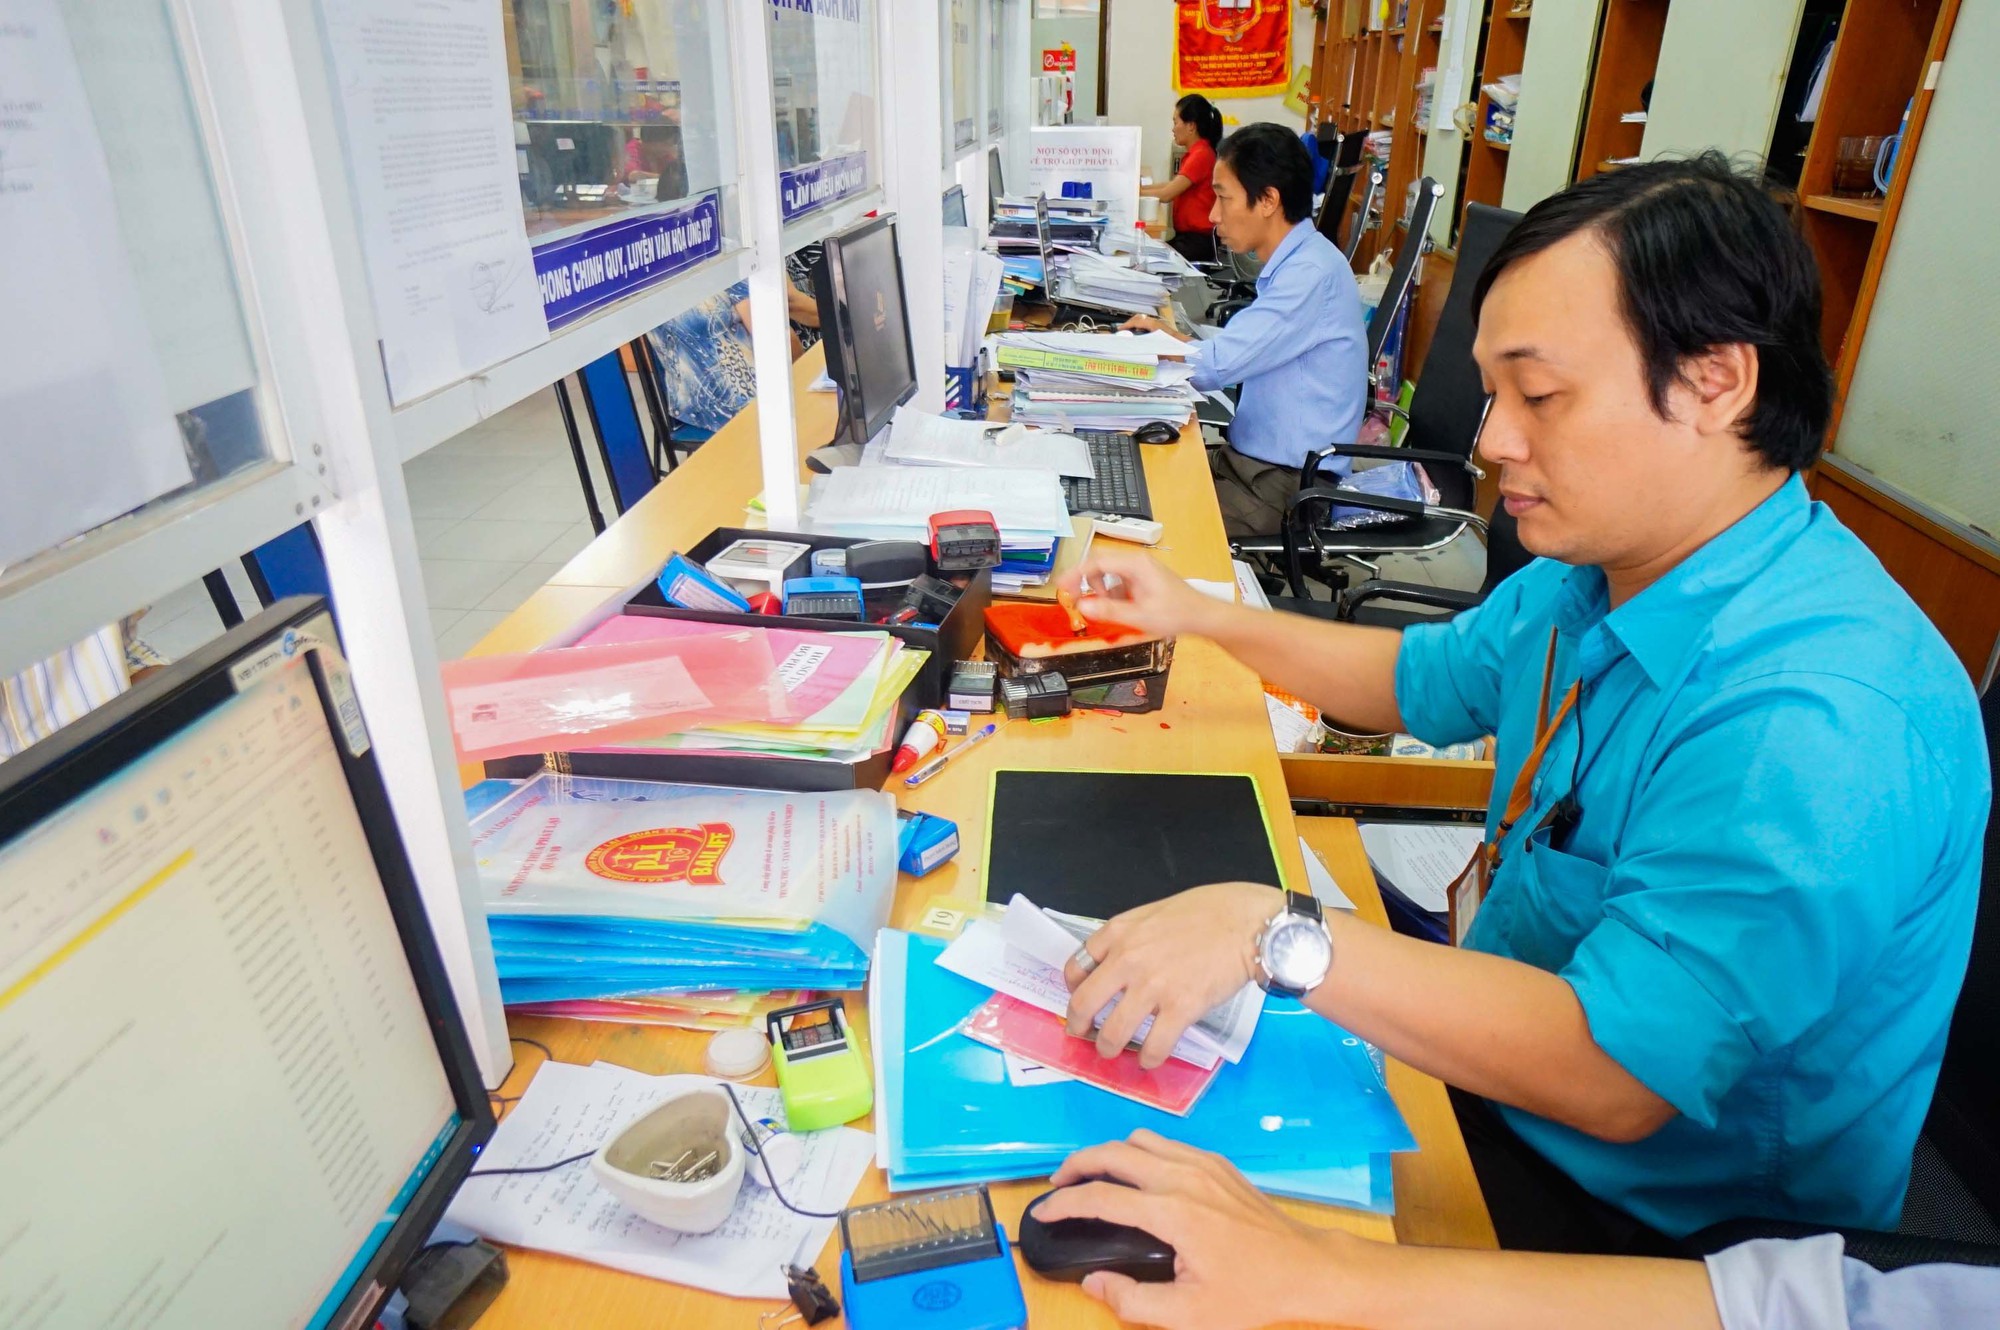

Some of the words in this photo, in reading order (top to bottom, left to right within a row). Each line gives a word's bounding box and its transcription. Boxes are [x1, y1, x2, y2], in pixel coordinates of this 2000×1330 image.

[1071, 147, 1089, 157] QUY
[572, 250, 606, 294] CHÍNH
[605, 246, 628, 279] QUY,
[627, 231, 656, 273] LUYỆN
[654, 227, 672, 261] VĂN
[671, 220, 688, 254] HÓA
[690, 832, 731, 877] BAILIFF
[931, 910, 956, 926] 19
